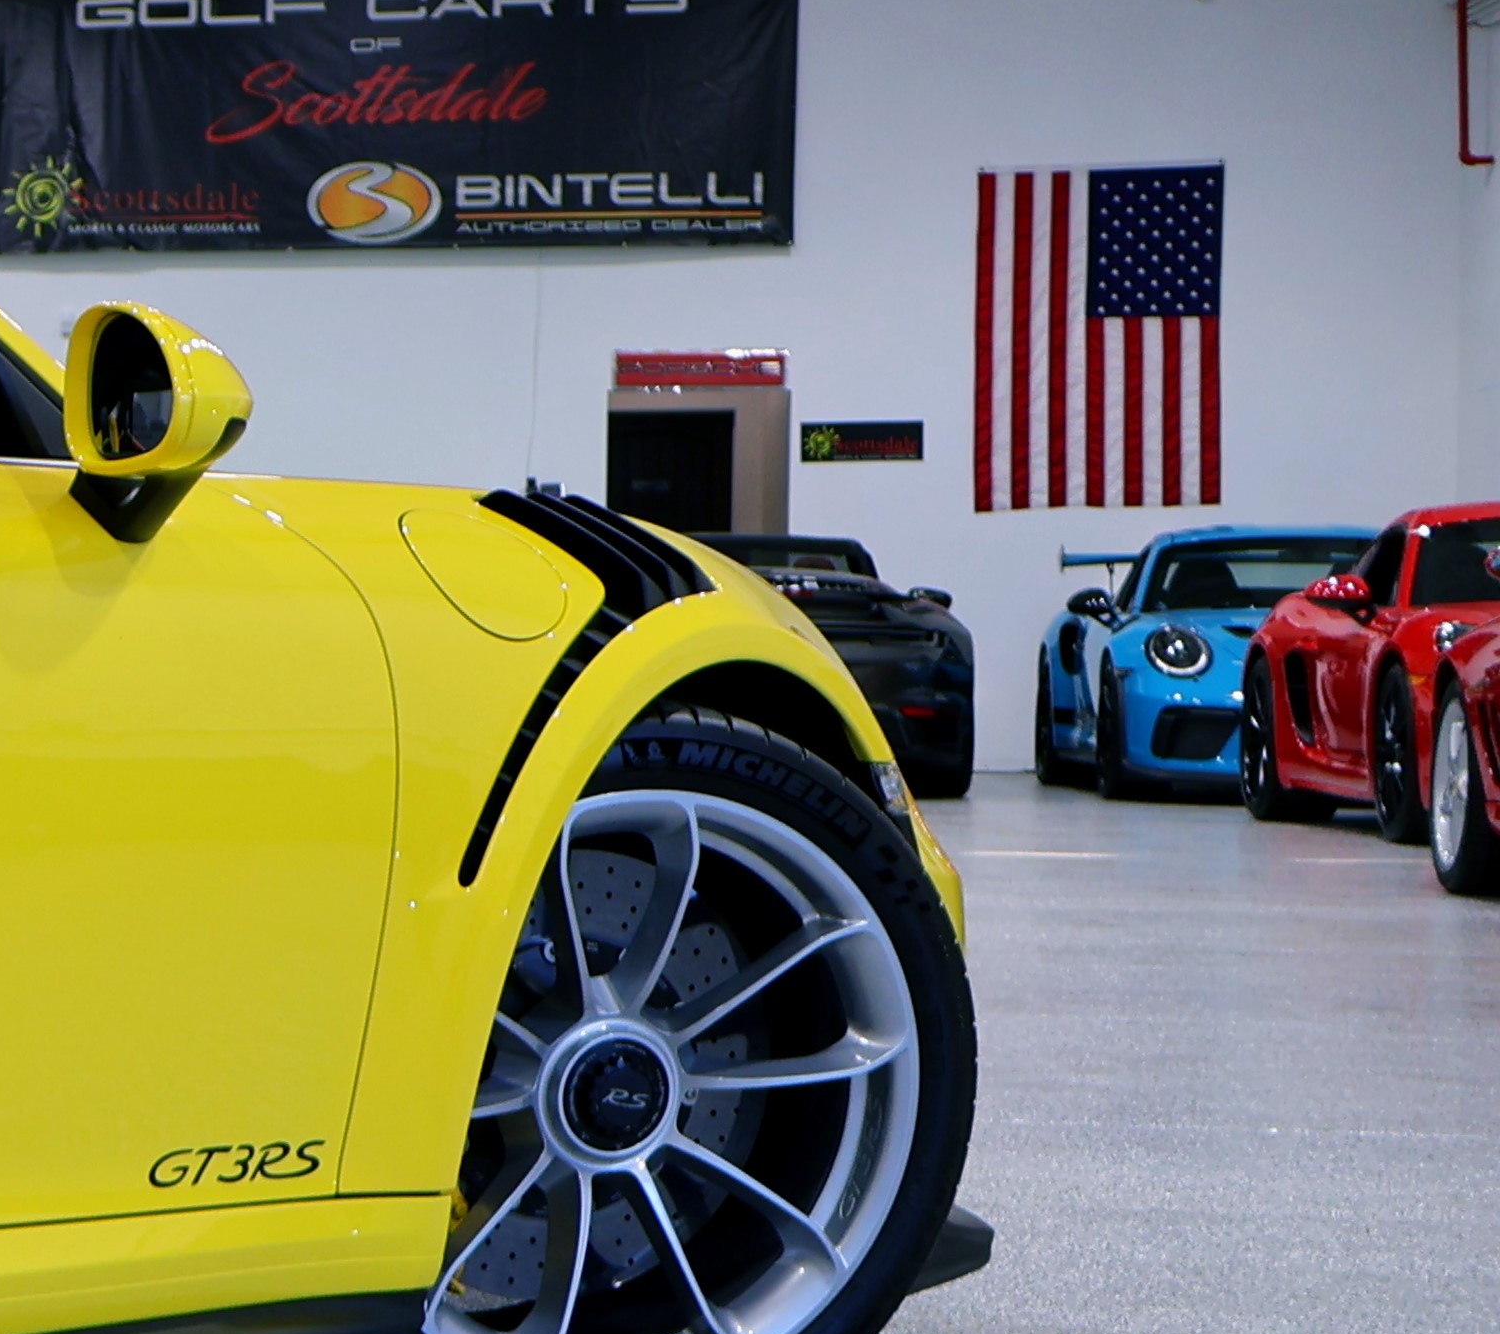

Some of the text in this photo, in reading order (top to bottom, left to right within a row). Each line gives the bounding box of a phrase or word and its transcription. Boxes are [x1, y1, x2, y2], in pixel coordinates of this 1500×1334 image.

[349, 36, 402, 54] OF
[205, 58, 549, 144] Scottsdale
[68, 180, 261, 215] Scottsdale
[456, 172, 765, 209] BINTELLI
[650, 218, 765, 233] DEALER
[676, 740, 871, 846] MICHELIN
[601, 1088, 652, 1108] RS
